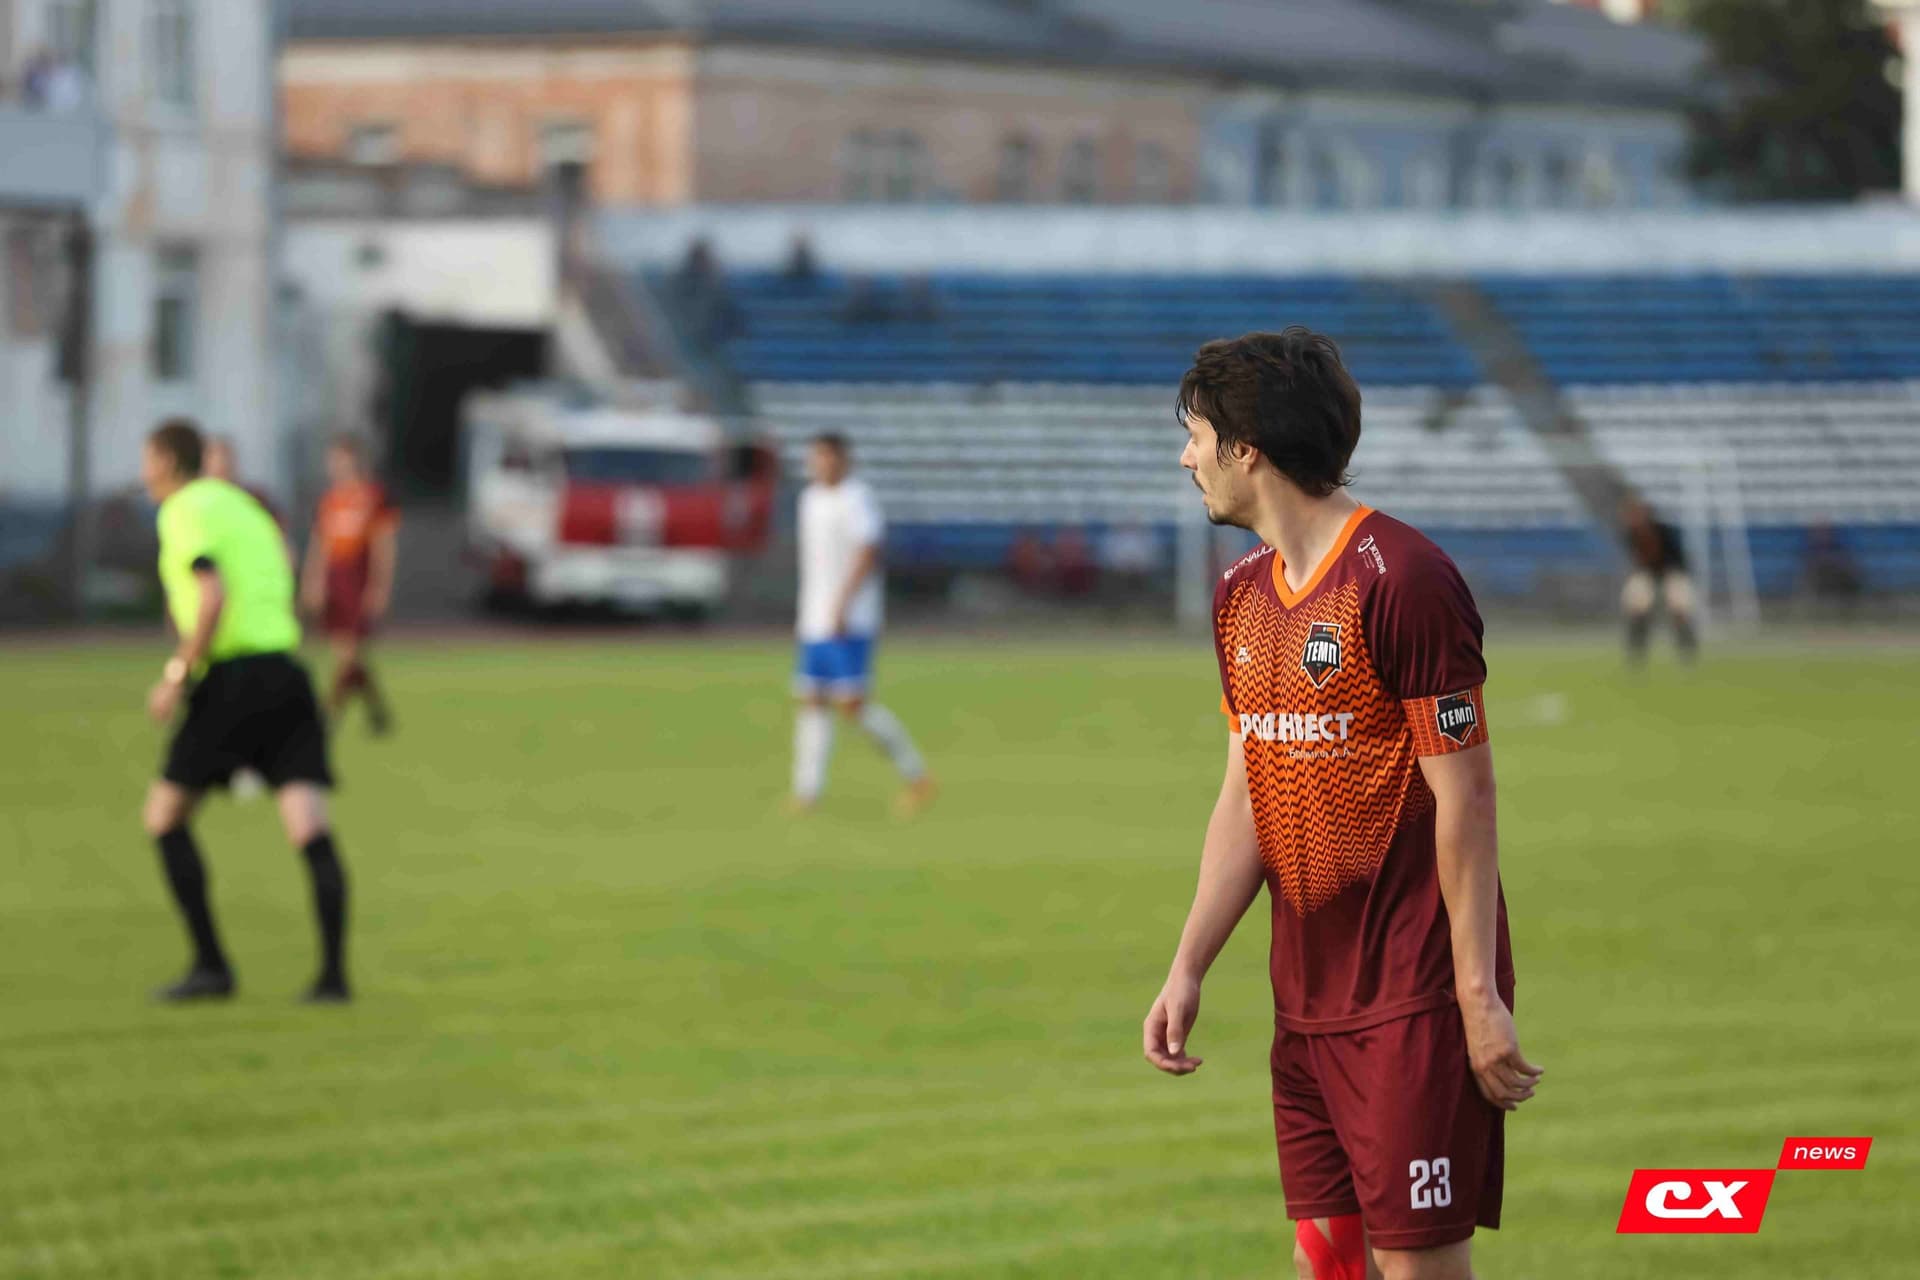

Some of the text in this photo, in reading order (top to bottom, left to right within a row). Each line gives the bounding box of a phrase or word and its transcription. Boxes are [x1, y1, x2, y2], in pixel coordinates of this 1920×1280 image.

[1306, 641, 1338, 665] ТЕМП
[1440, 706, 1474, 729] ТЕМП
[1409, 1156, 1452, 1210] 23
